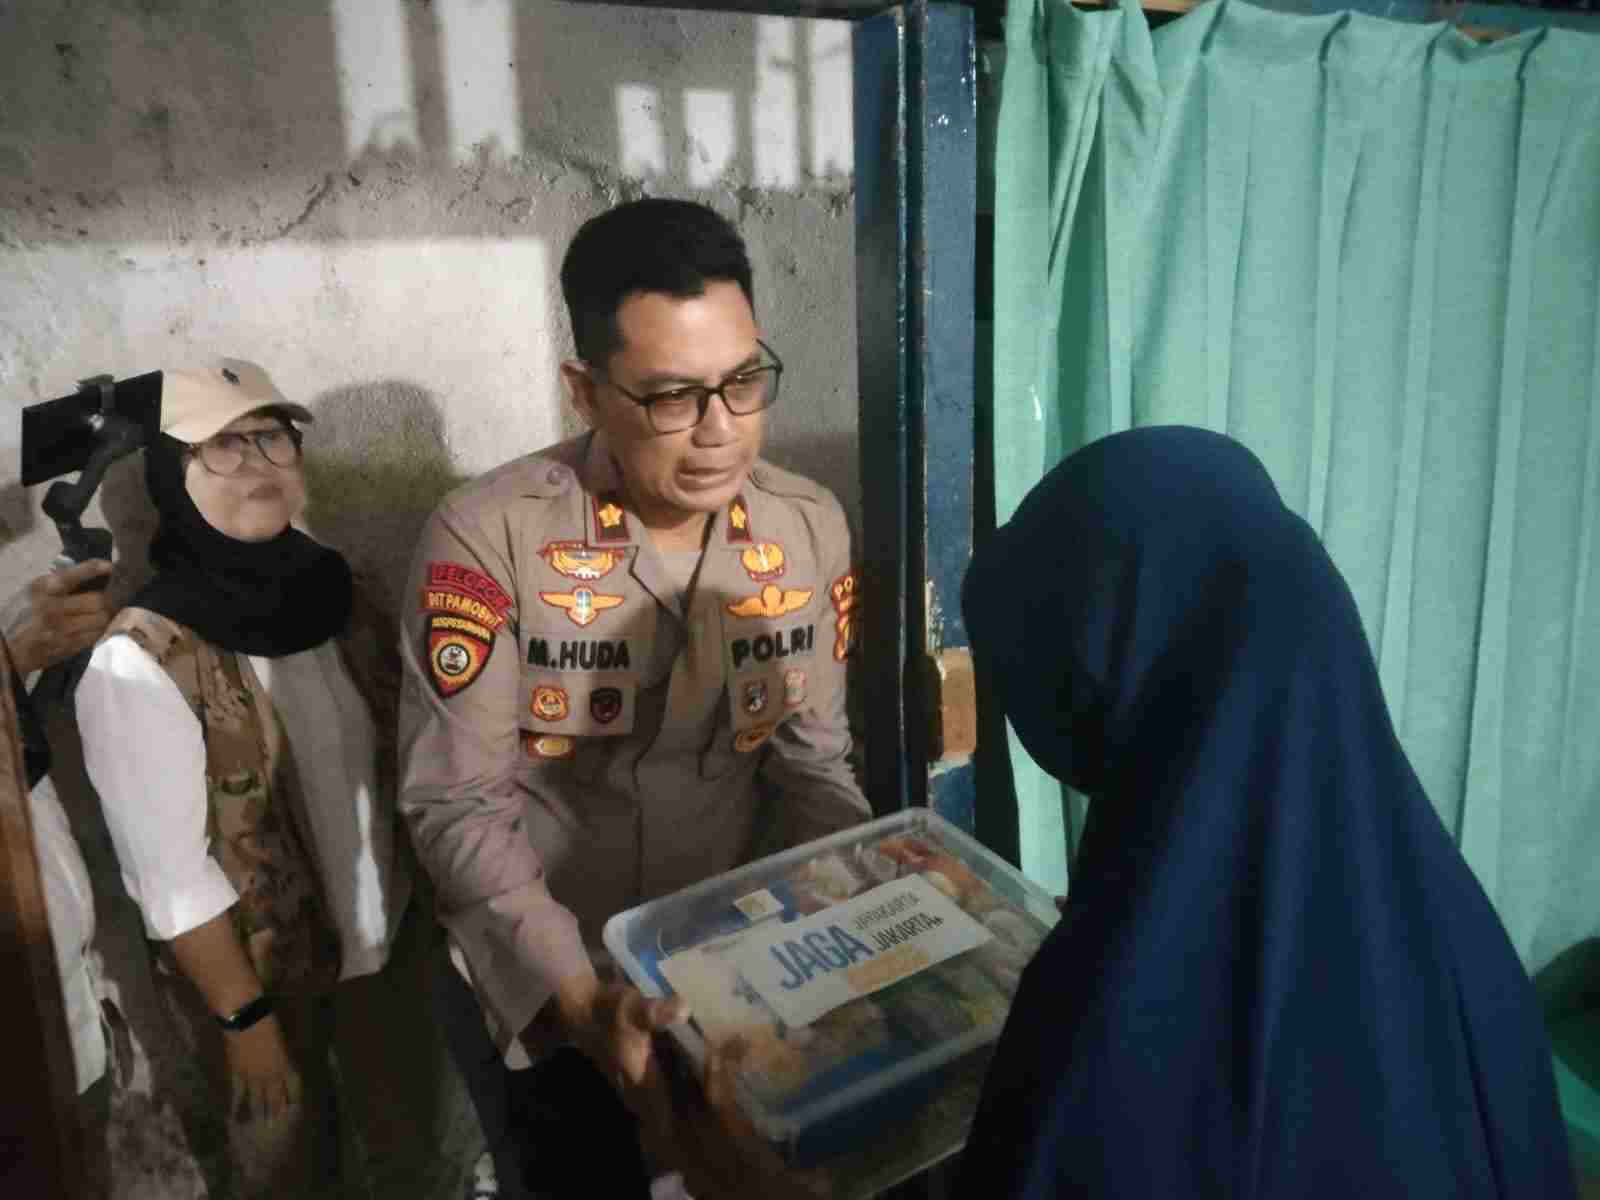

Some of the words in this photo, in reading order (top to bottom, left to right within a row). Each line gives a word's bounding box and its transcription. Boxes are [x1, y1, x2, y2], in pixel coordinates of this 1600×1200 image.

[528, 637, 630, 670] M.HUDA
[732, 624, 814, 669] POLRI
[769, 924, 874, 990] JAGA
